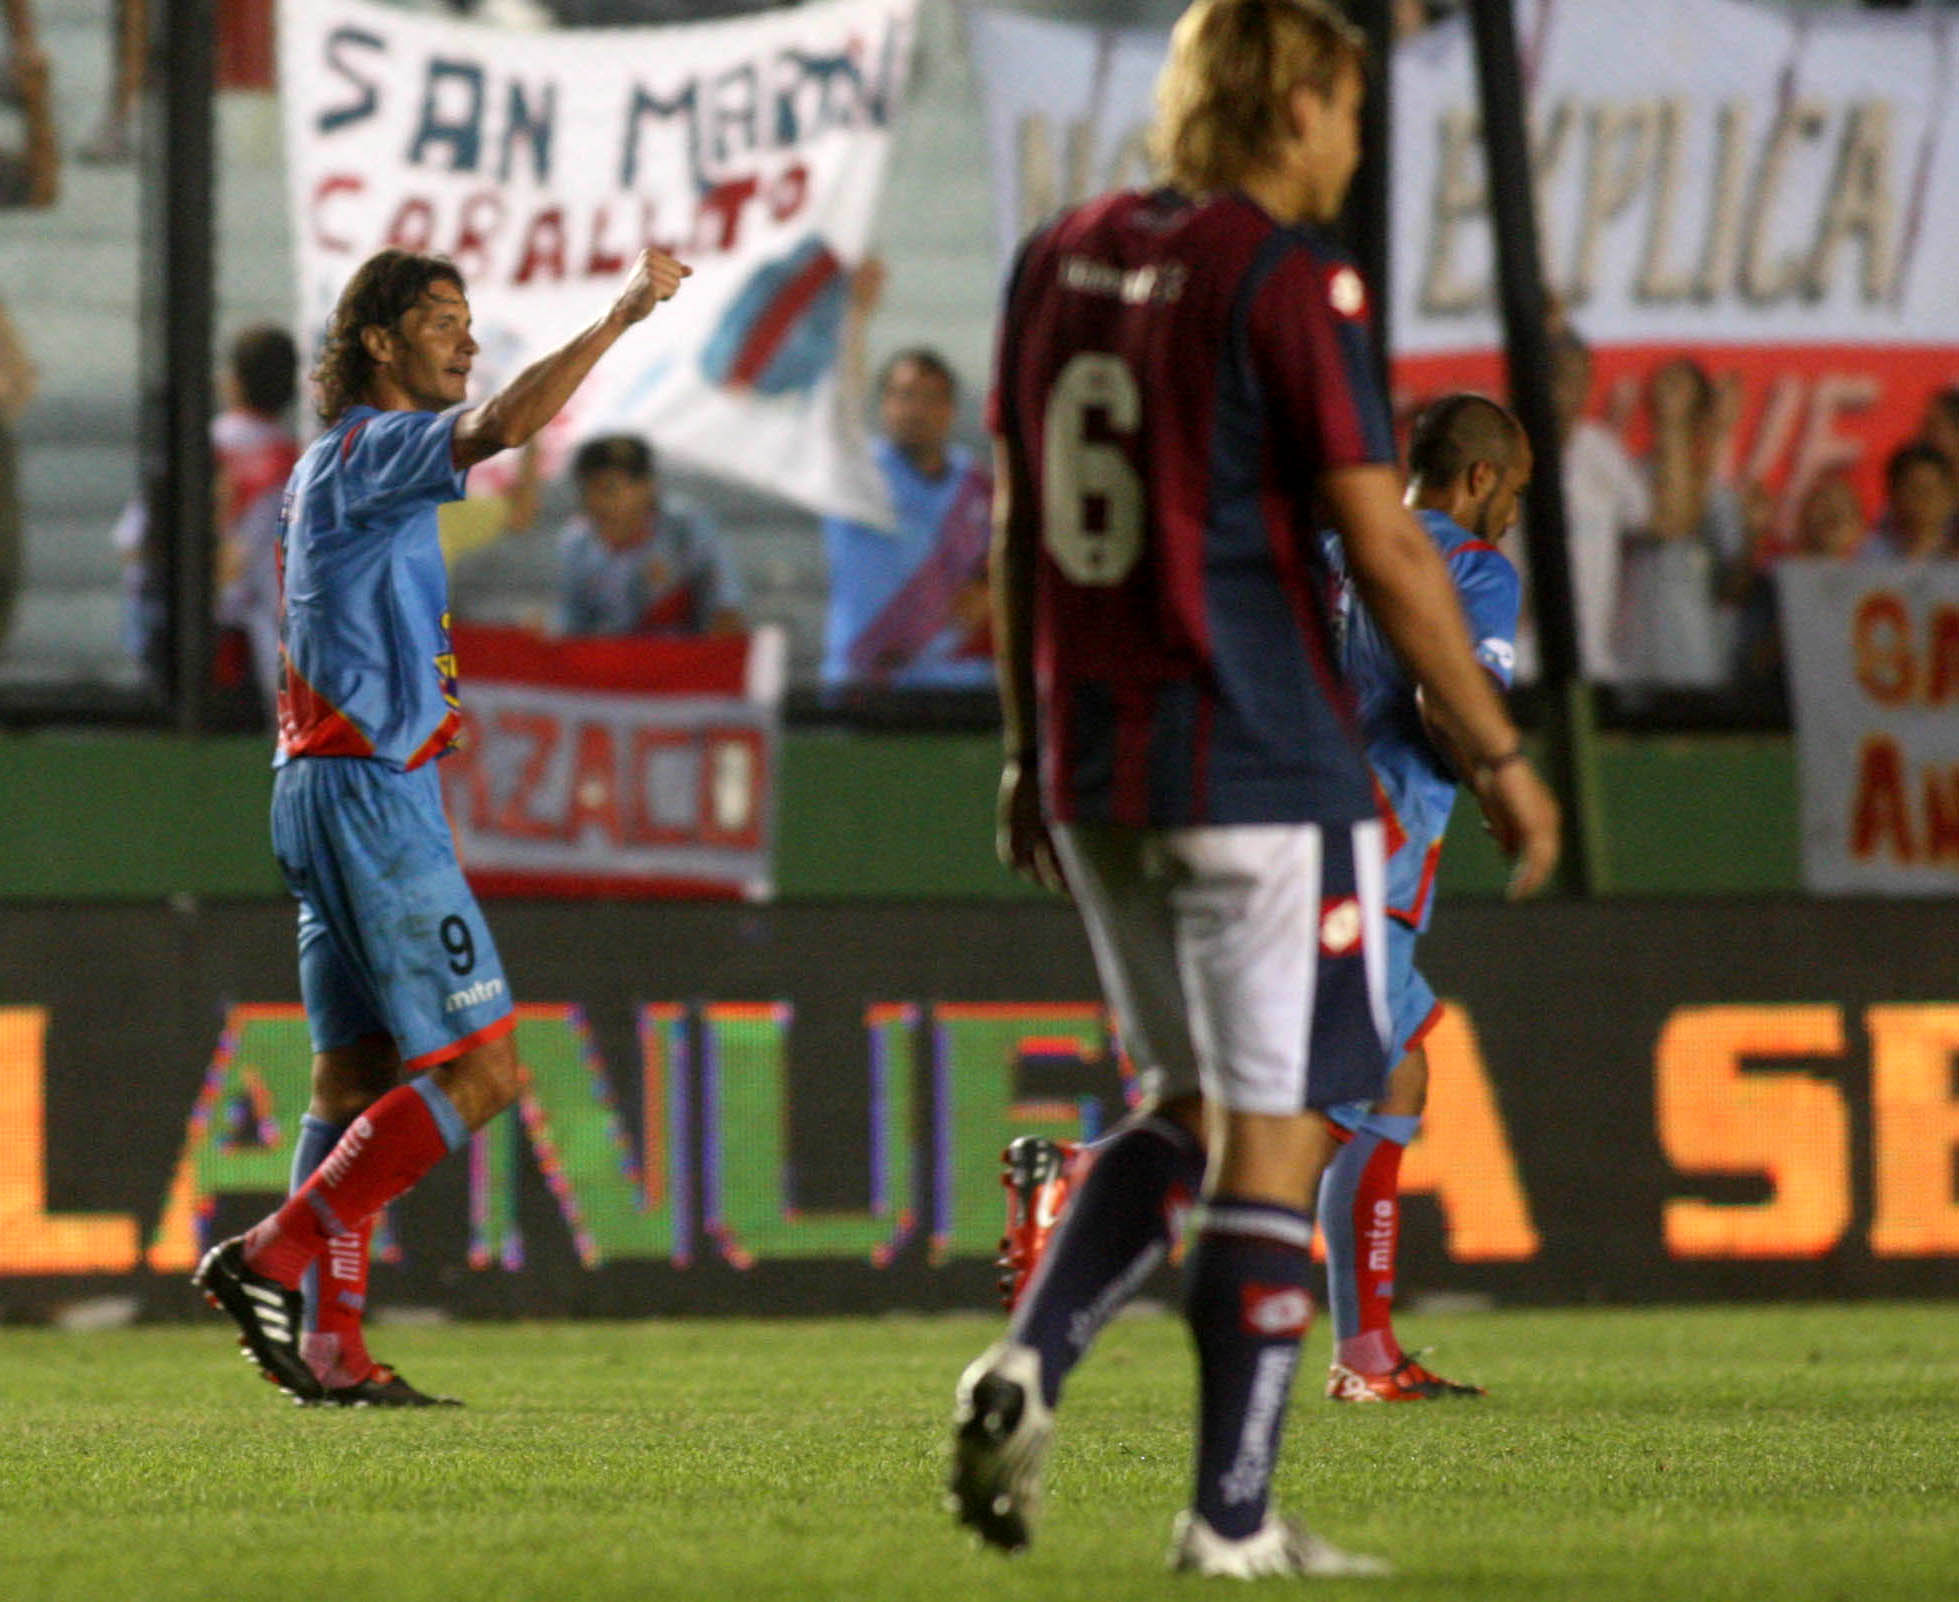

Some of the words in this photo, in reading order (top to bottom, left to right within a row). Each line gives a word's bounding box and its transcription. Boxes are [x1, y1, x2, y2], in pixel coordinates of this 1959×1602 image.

[309, 26, 557, 186] SAN
[1044, 354, 1145, 586] 6
[441, 914, 475, 976] 9
[446, 978, 504, 1014] mitr
[0, 1003, 402, 1272] LA
[470, 1000, 1542, 1270] NUEA
[1364, 1199, 1394, 1272] mitro
